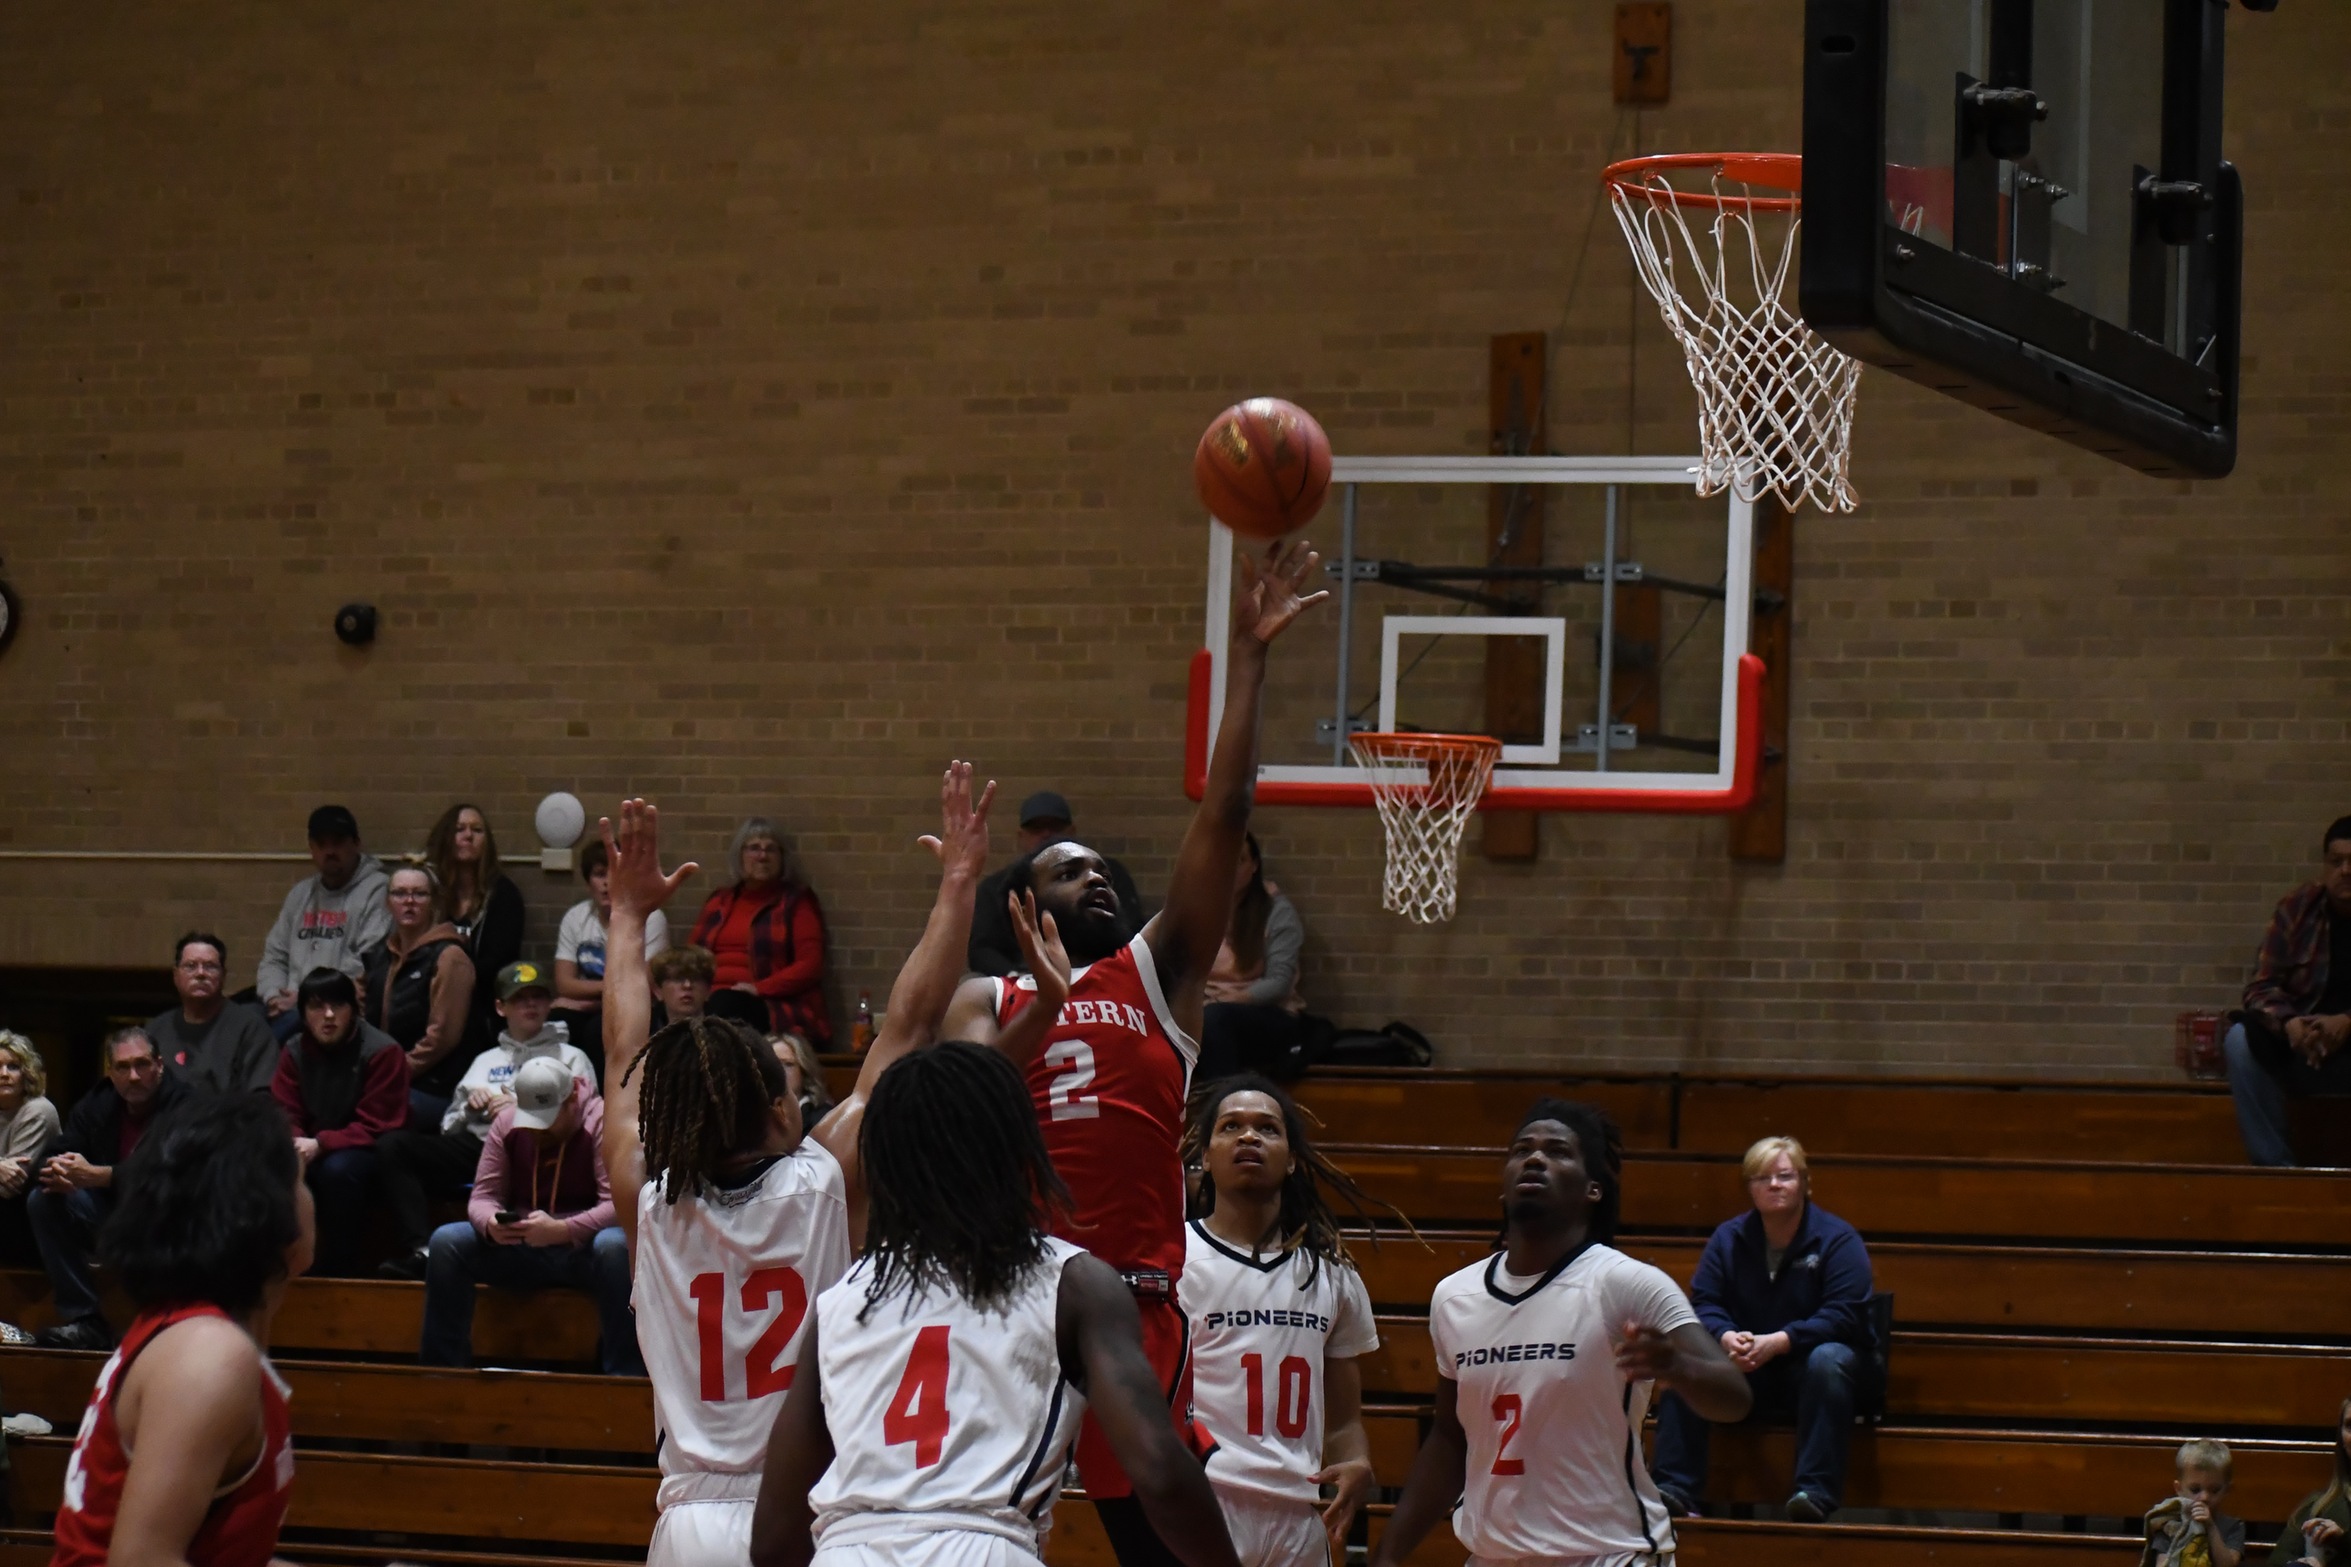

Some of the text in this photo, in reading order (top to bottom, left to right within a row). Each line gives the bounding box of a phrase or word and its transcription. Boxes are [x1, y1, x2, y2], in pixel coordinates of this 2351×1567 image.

[1056, 1001, 1148, 1037] TERN
[1044, 1039, 1100, 1122] 2
[690, 1266, 808, 1401] 12
[883, 1325, 951, 1470] 4
[1240, 1353, 1311, 1439] 10
[1491, 1393, 1525, 1476] 2
